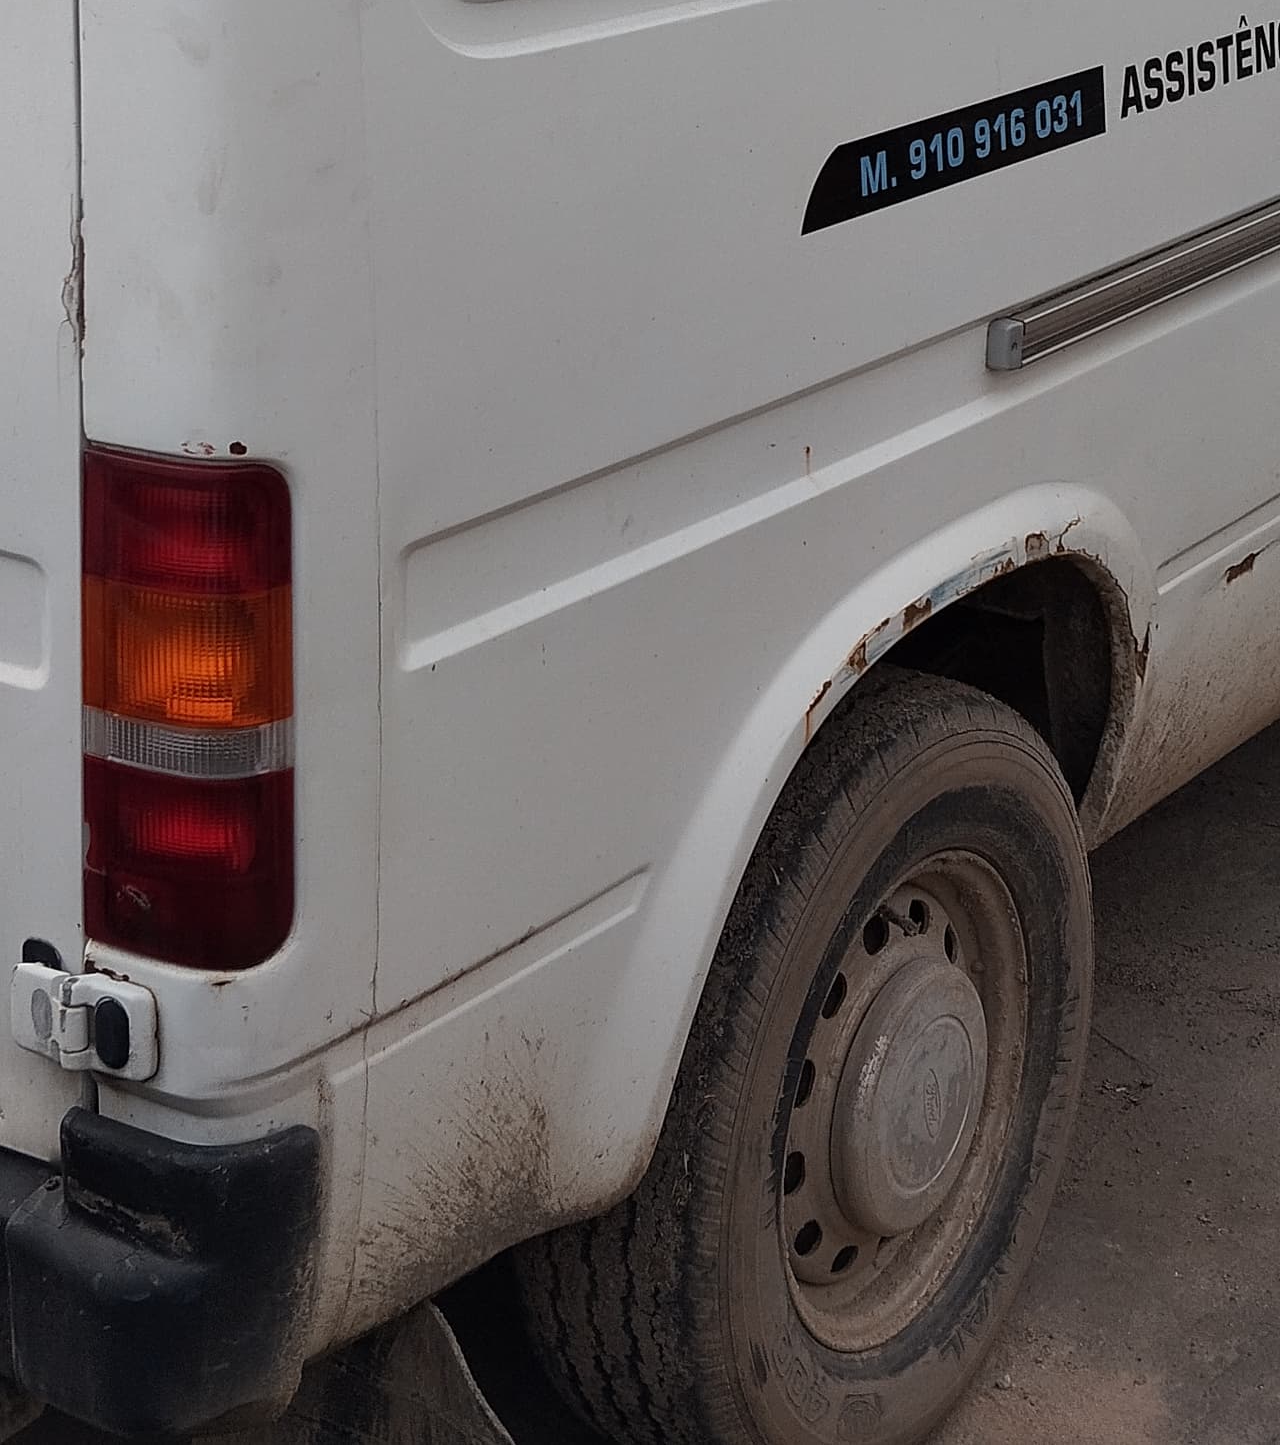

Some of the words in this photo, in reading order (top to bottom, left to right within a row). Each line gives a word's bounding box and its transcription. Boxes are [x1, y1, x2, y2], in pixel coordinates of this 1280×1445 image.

[860, 154, 898, 197] M.
[909, 127, 965, 181] 910
[974, 107, 1027, 160] 916
[1035, 89, 1084, 139] 031
